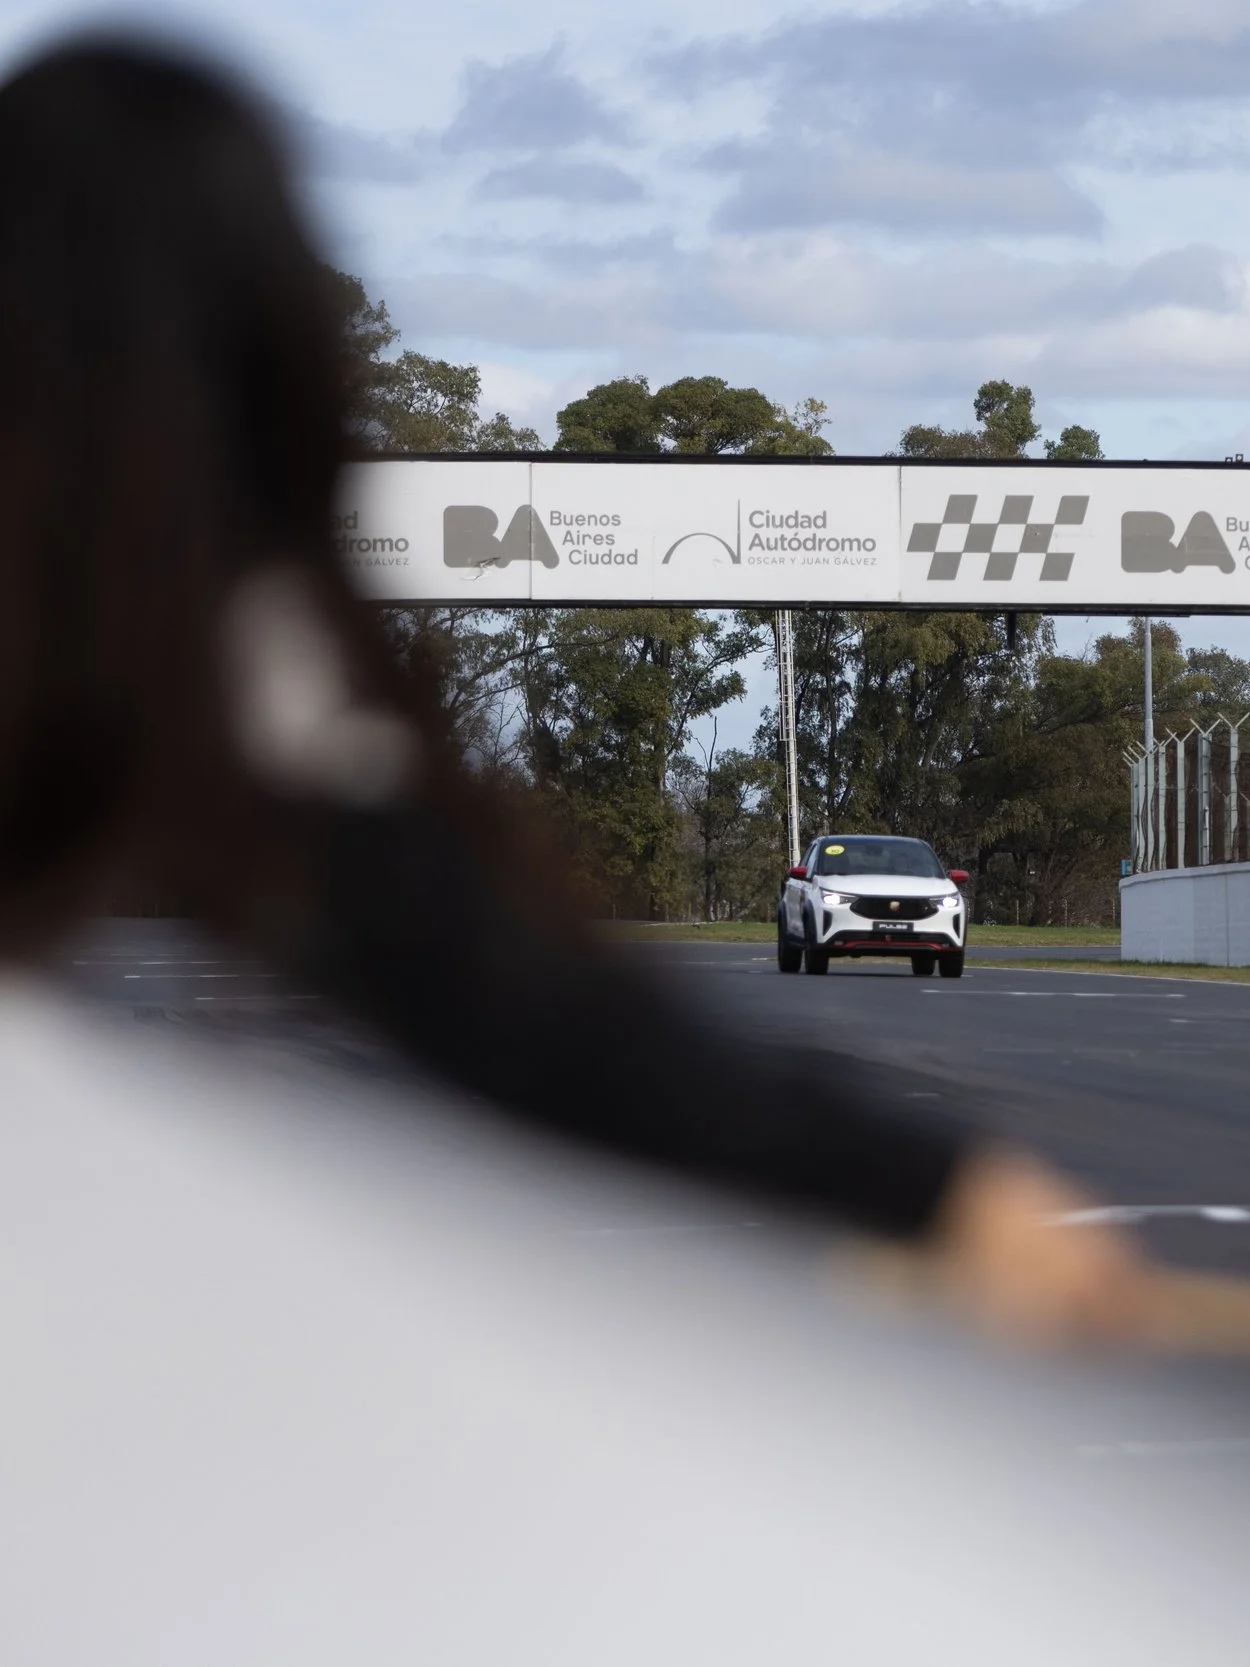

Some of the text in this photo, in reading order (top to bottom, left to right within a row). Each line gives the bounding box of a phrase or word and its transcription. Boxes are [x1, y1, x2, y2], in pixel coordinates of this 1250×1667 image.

[549, 510, 622, 527] Buenos
[748, 509, 827, 529] Ciudad
[443, 504, 560, 569] BA
[562, 529, 616, 546] Aires
[748, 531, 877, 552] Autódromo
[1121, 511, 1236, 575] BA
[568, 548, 639, 566] Ciudad
[747, 554, 878, 566] OSCAR Y JUAN GÁLVEZ
